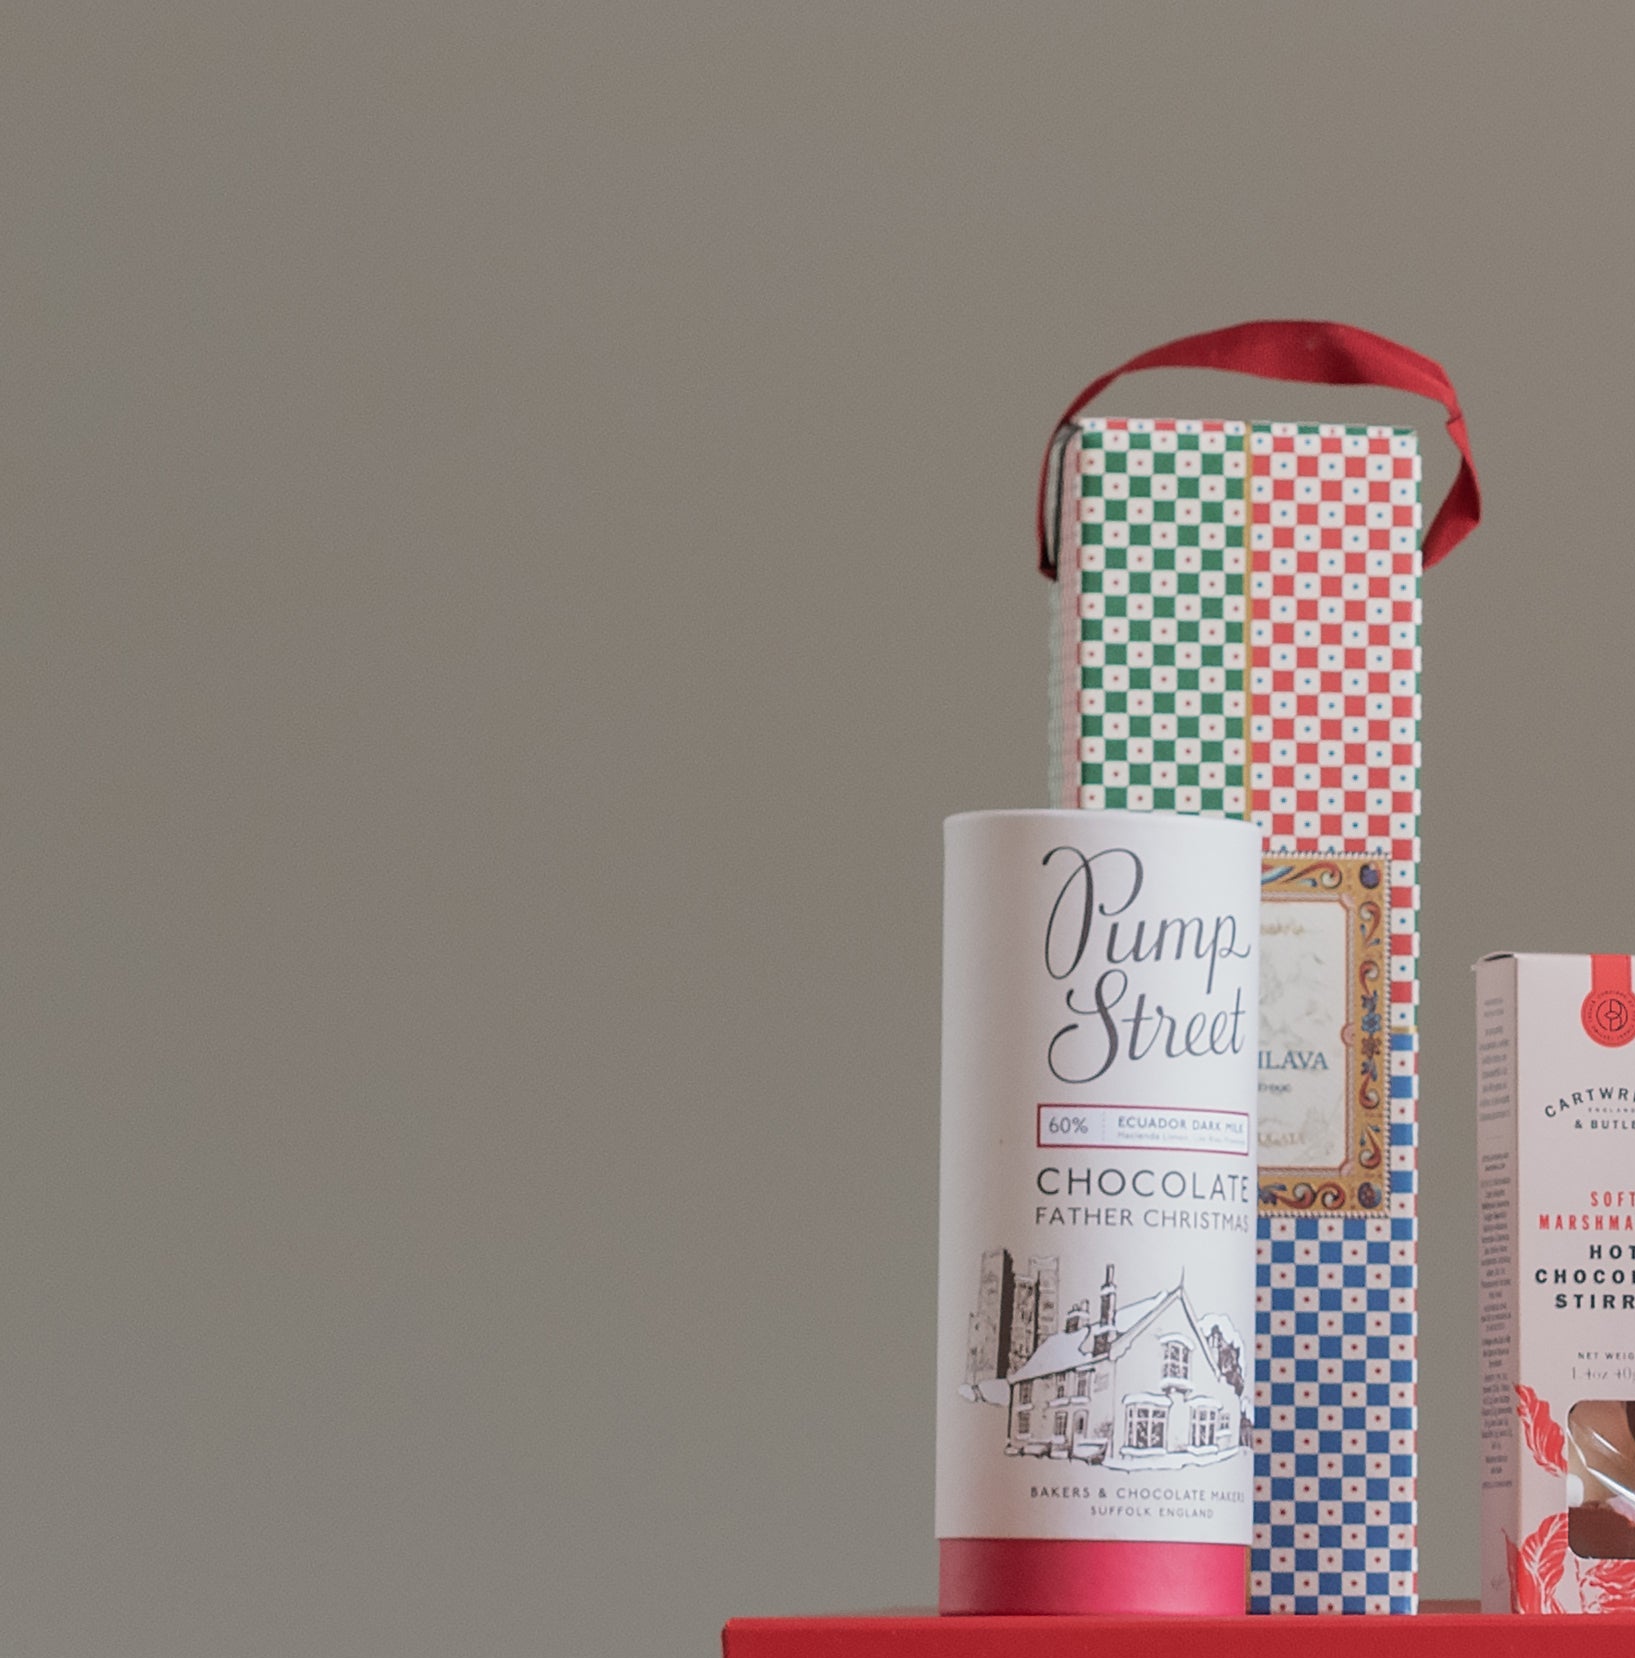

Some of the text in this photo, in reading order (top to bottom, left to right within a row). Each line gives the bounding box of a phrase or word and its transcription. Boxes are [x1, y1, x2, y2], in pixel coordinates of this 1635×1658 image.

[1043, 846, 1251, 995] Pump
[1048, 969, 1245, 1084] Street
[1049, 1116, 1088, 1134] 60%
[1118, 1116, 1220, 1131] ECUADOR DARK
[1575, 1119, 1583, 1129] &
[1037, 1168, 1249, 1203] CHOCOLATE
[1591, 1191, 1635, 1207] SOFT
[1036, 1207, 1248, 1232] FATHER CHRISTMAS
[1030, 1487, 1245, 1503] BAKERS & CHOCOLATE MAKERS
[1091, 1506, 1213, 1518] SUFFOLK ENGLAND
